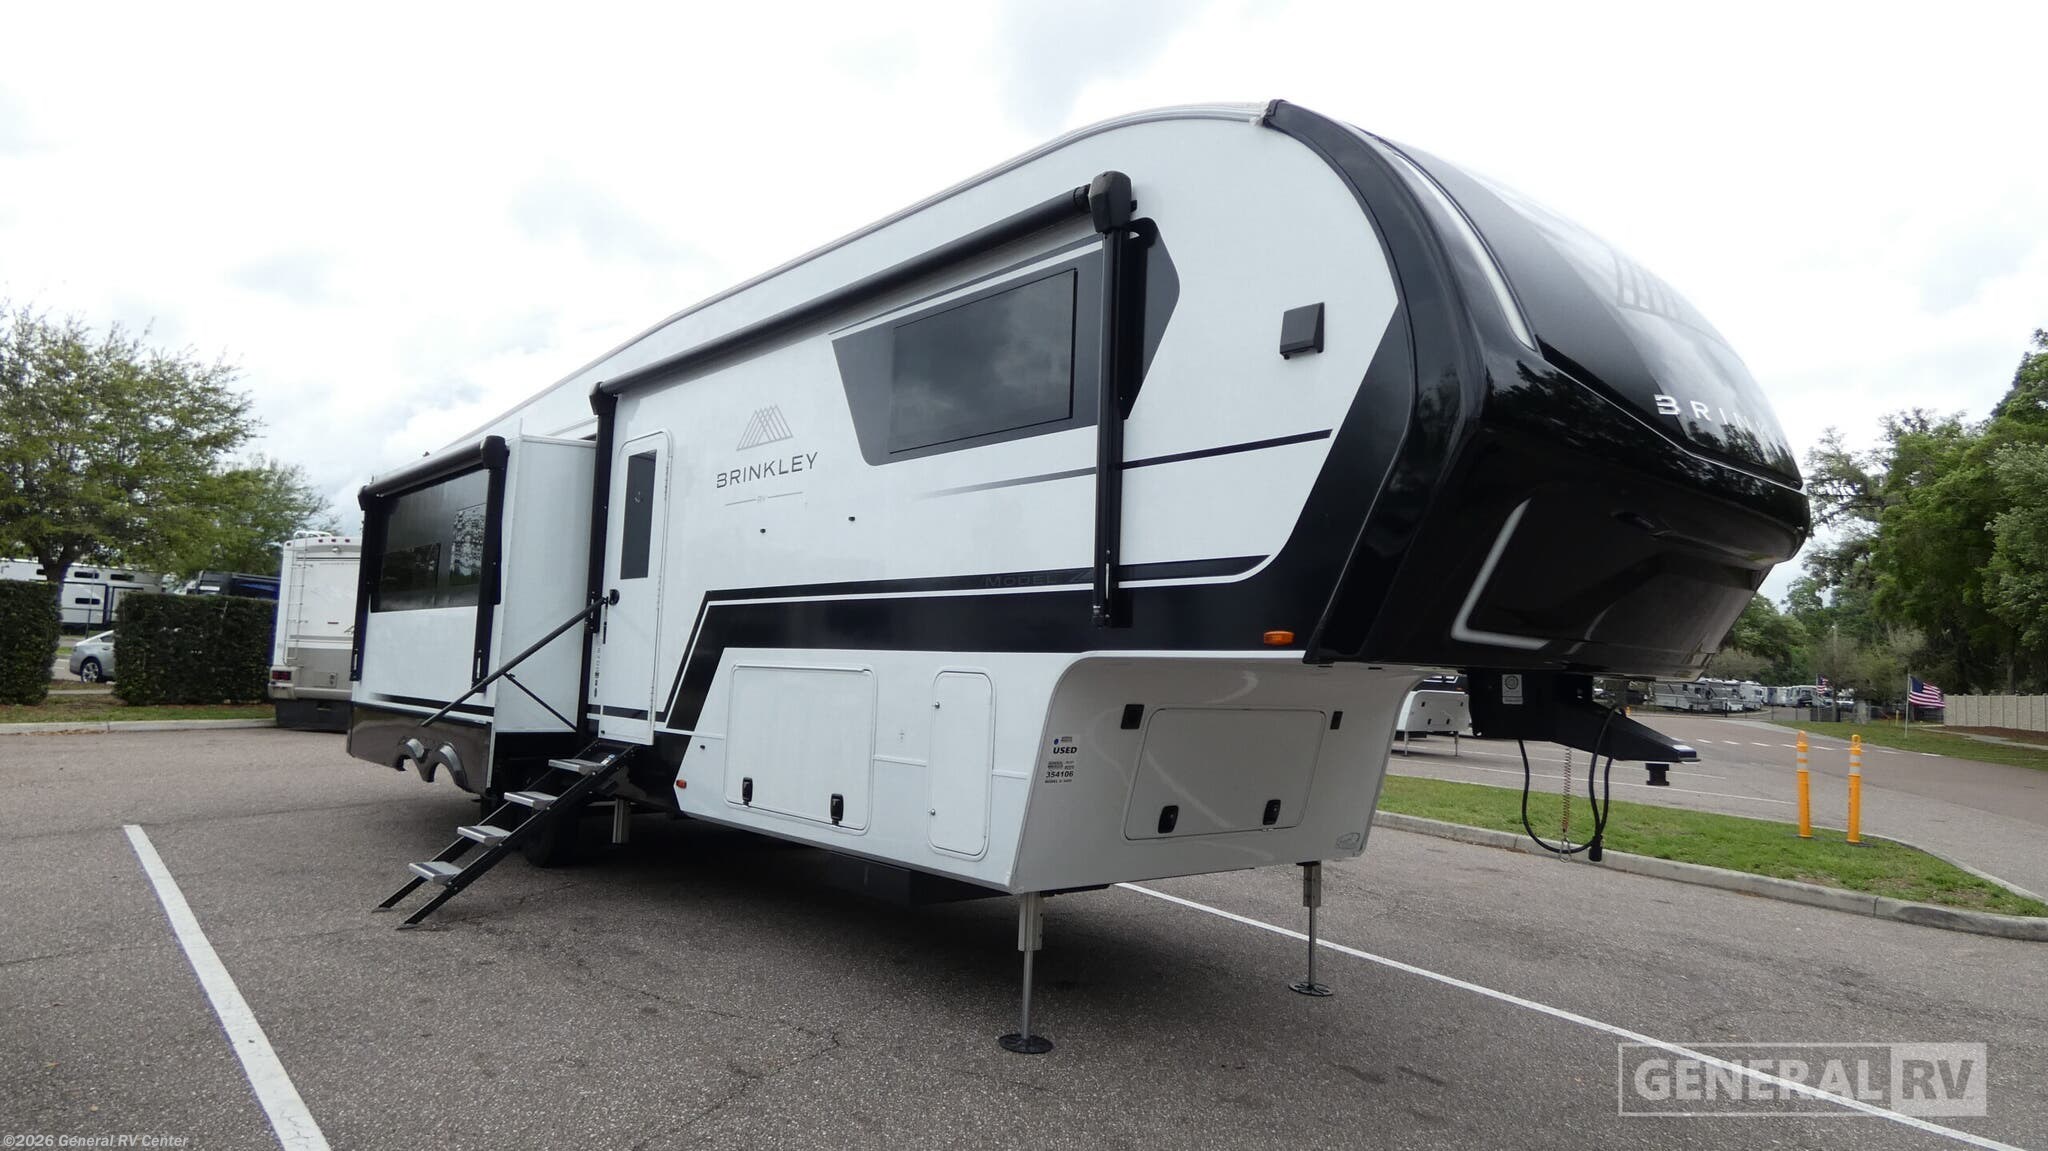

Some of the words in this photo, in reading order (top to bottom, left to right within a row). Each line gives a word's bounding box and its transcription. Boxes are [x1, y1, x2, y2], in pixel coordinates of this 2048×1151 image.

[716, 451, 818, 489] BRINKLEY
[1053, 746, 1077, 754] USED
[1045, 770, 1074, 778] 354106
